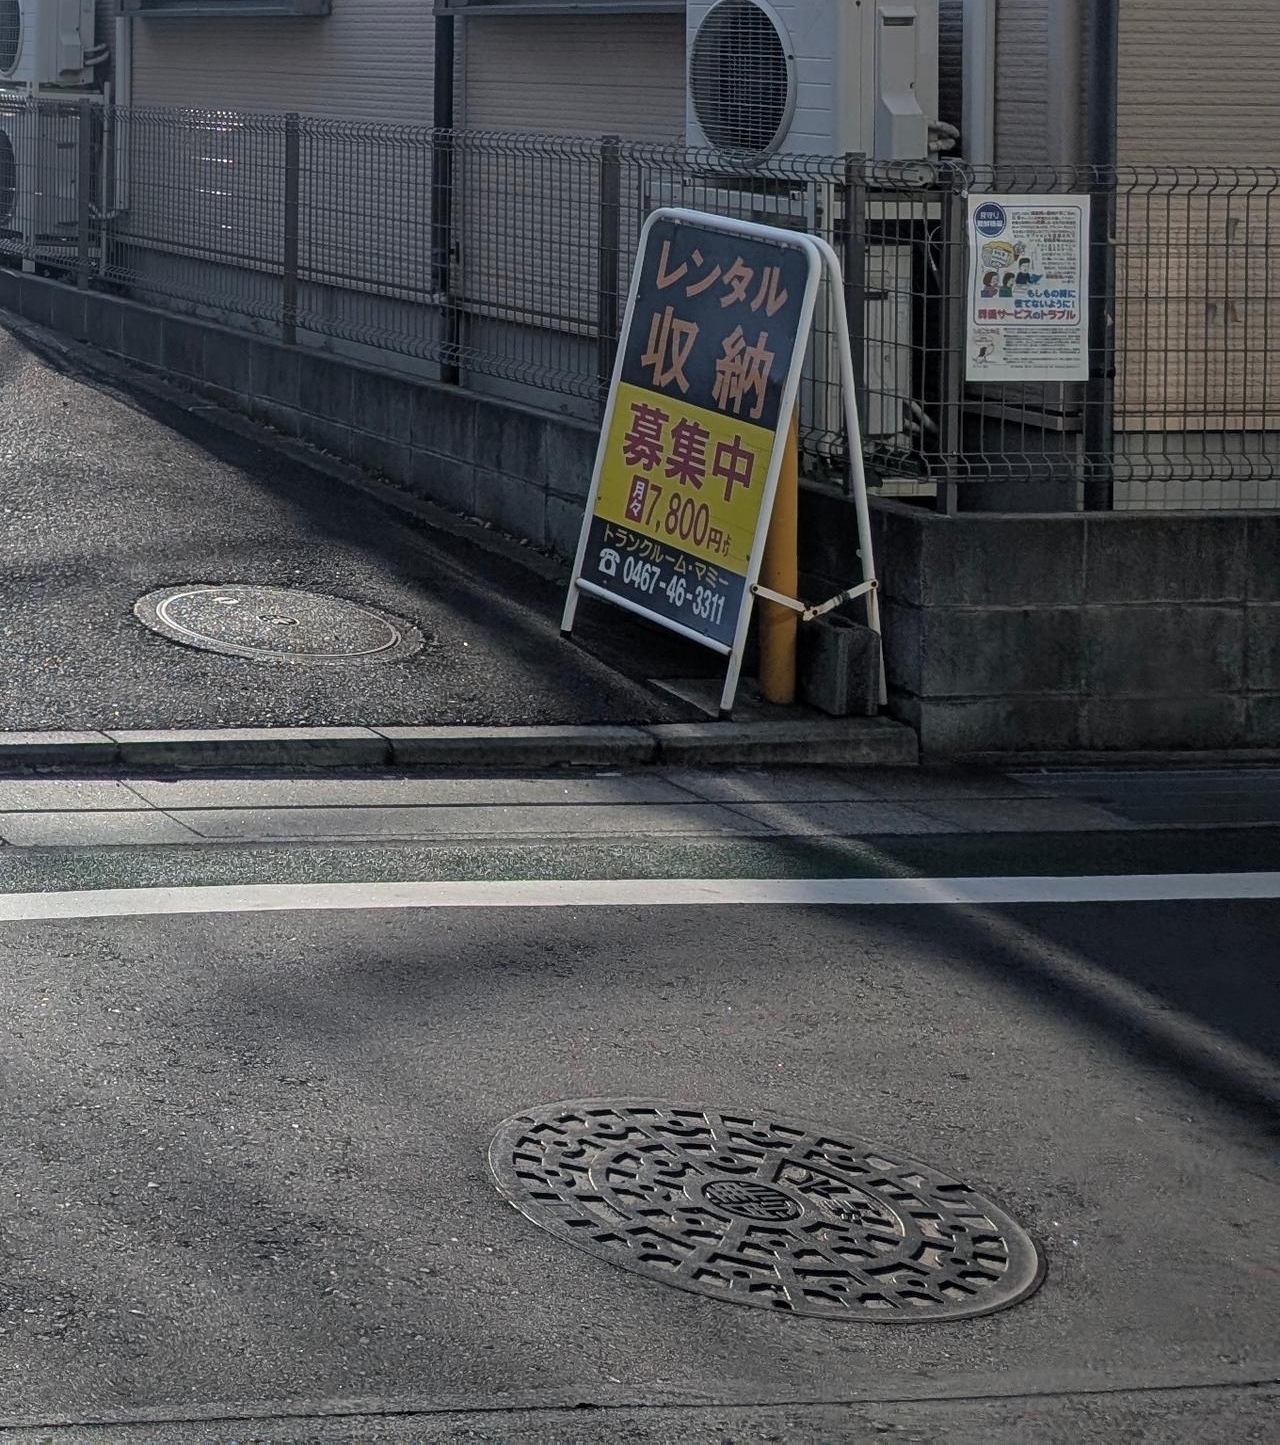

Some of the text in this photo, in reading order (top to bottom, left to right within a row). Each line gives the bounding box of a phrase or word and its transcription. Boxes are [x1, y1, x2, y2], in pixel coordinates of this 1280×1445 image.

[654, 240, 789, 318] レンタル
[623, 403, 756, 502] 募集中
[603, 524, 729, 588] トランクルーム・マミー
[623, 556, 726, 625] 0467-46-3311
